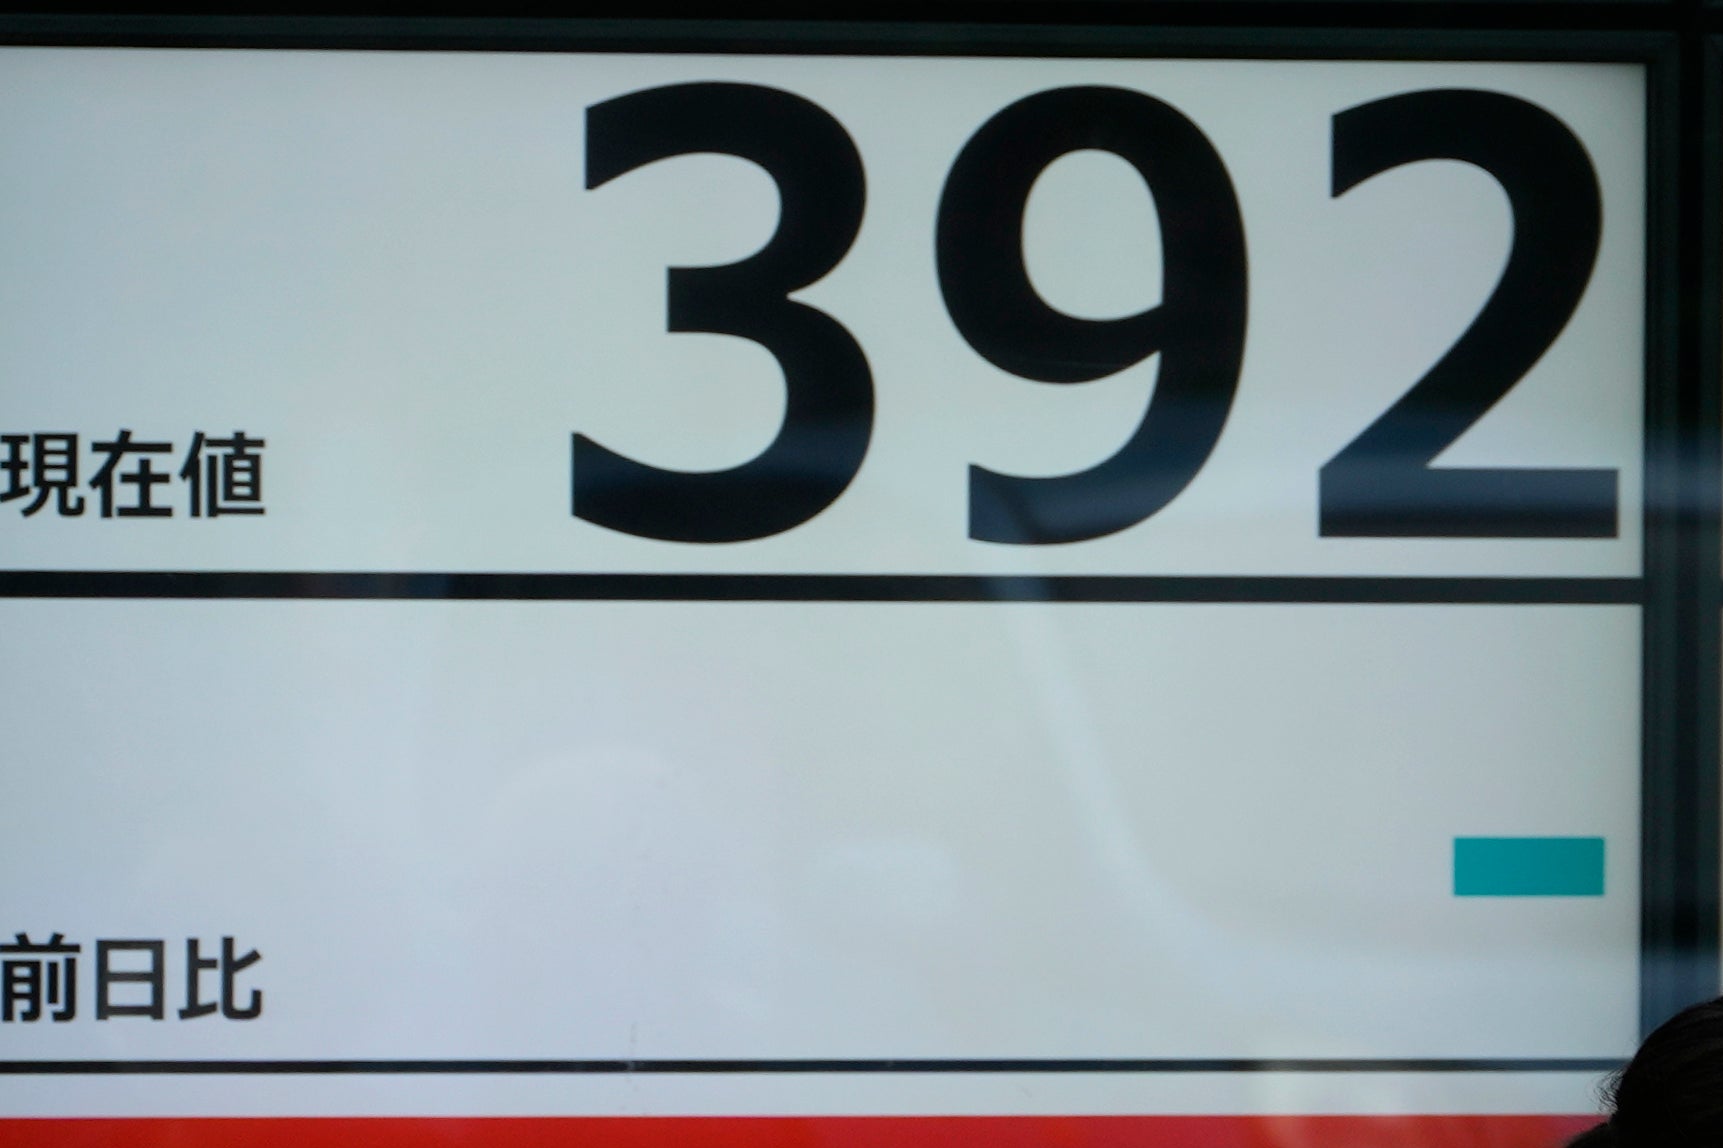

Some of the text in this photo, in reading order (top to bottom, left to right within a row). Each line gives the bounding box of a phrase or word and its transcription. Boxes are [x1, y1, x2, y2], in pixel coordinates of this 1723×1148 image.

[0, 429, 265, 518] 現在値
[0, 932, 262, 1022] 前日比
